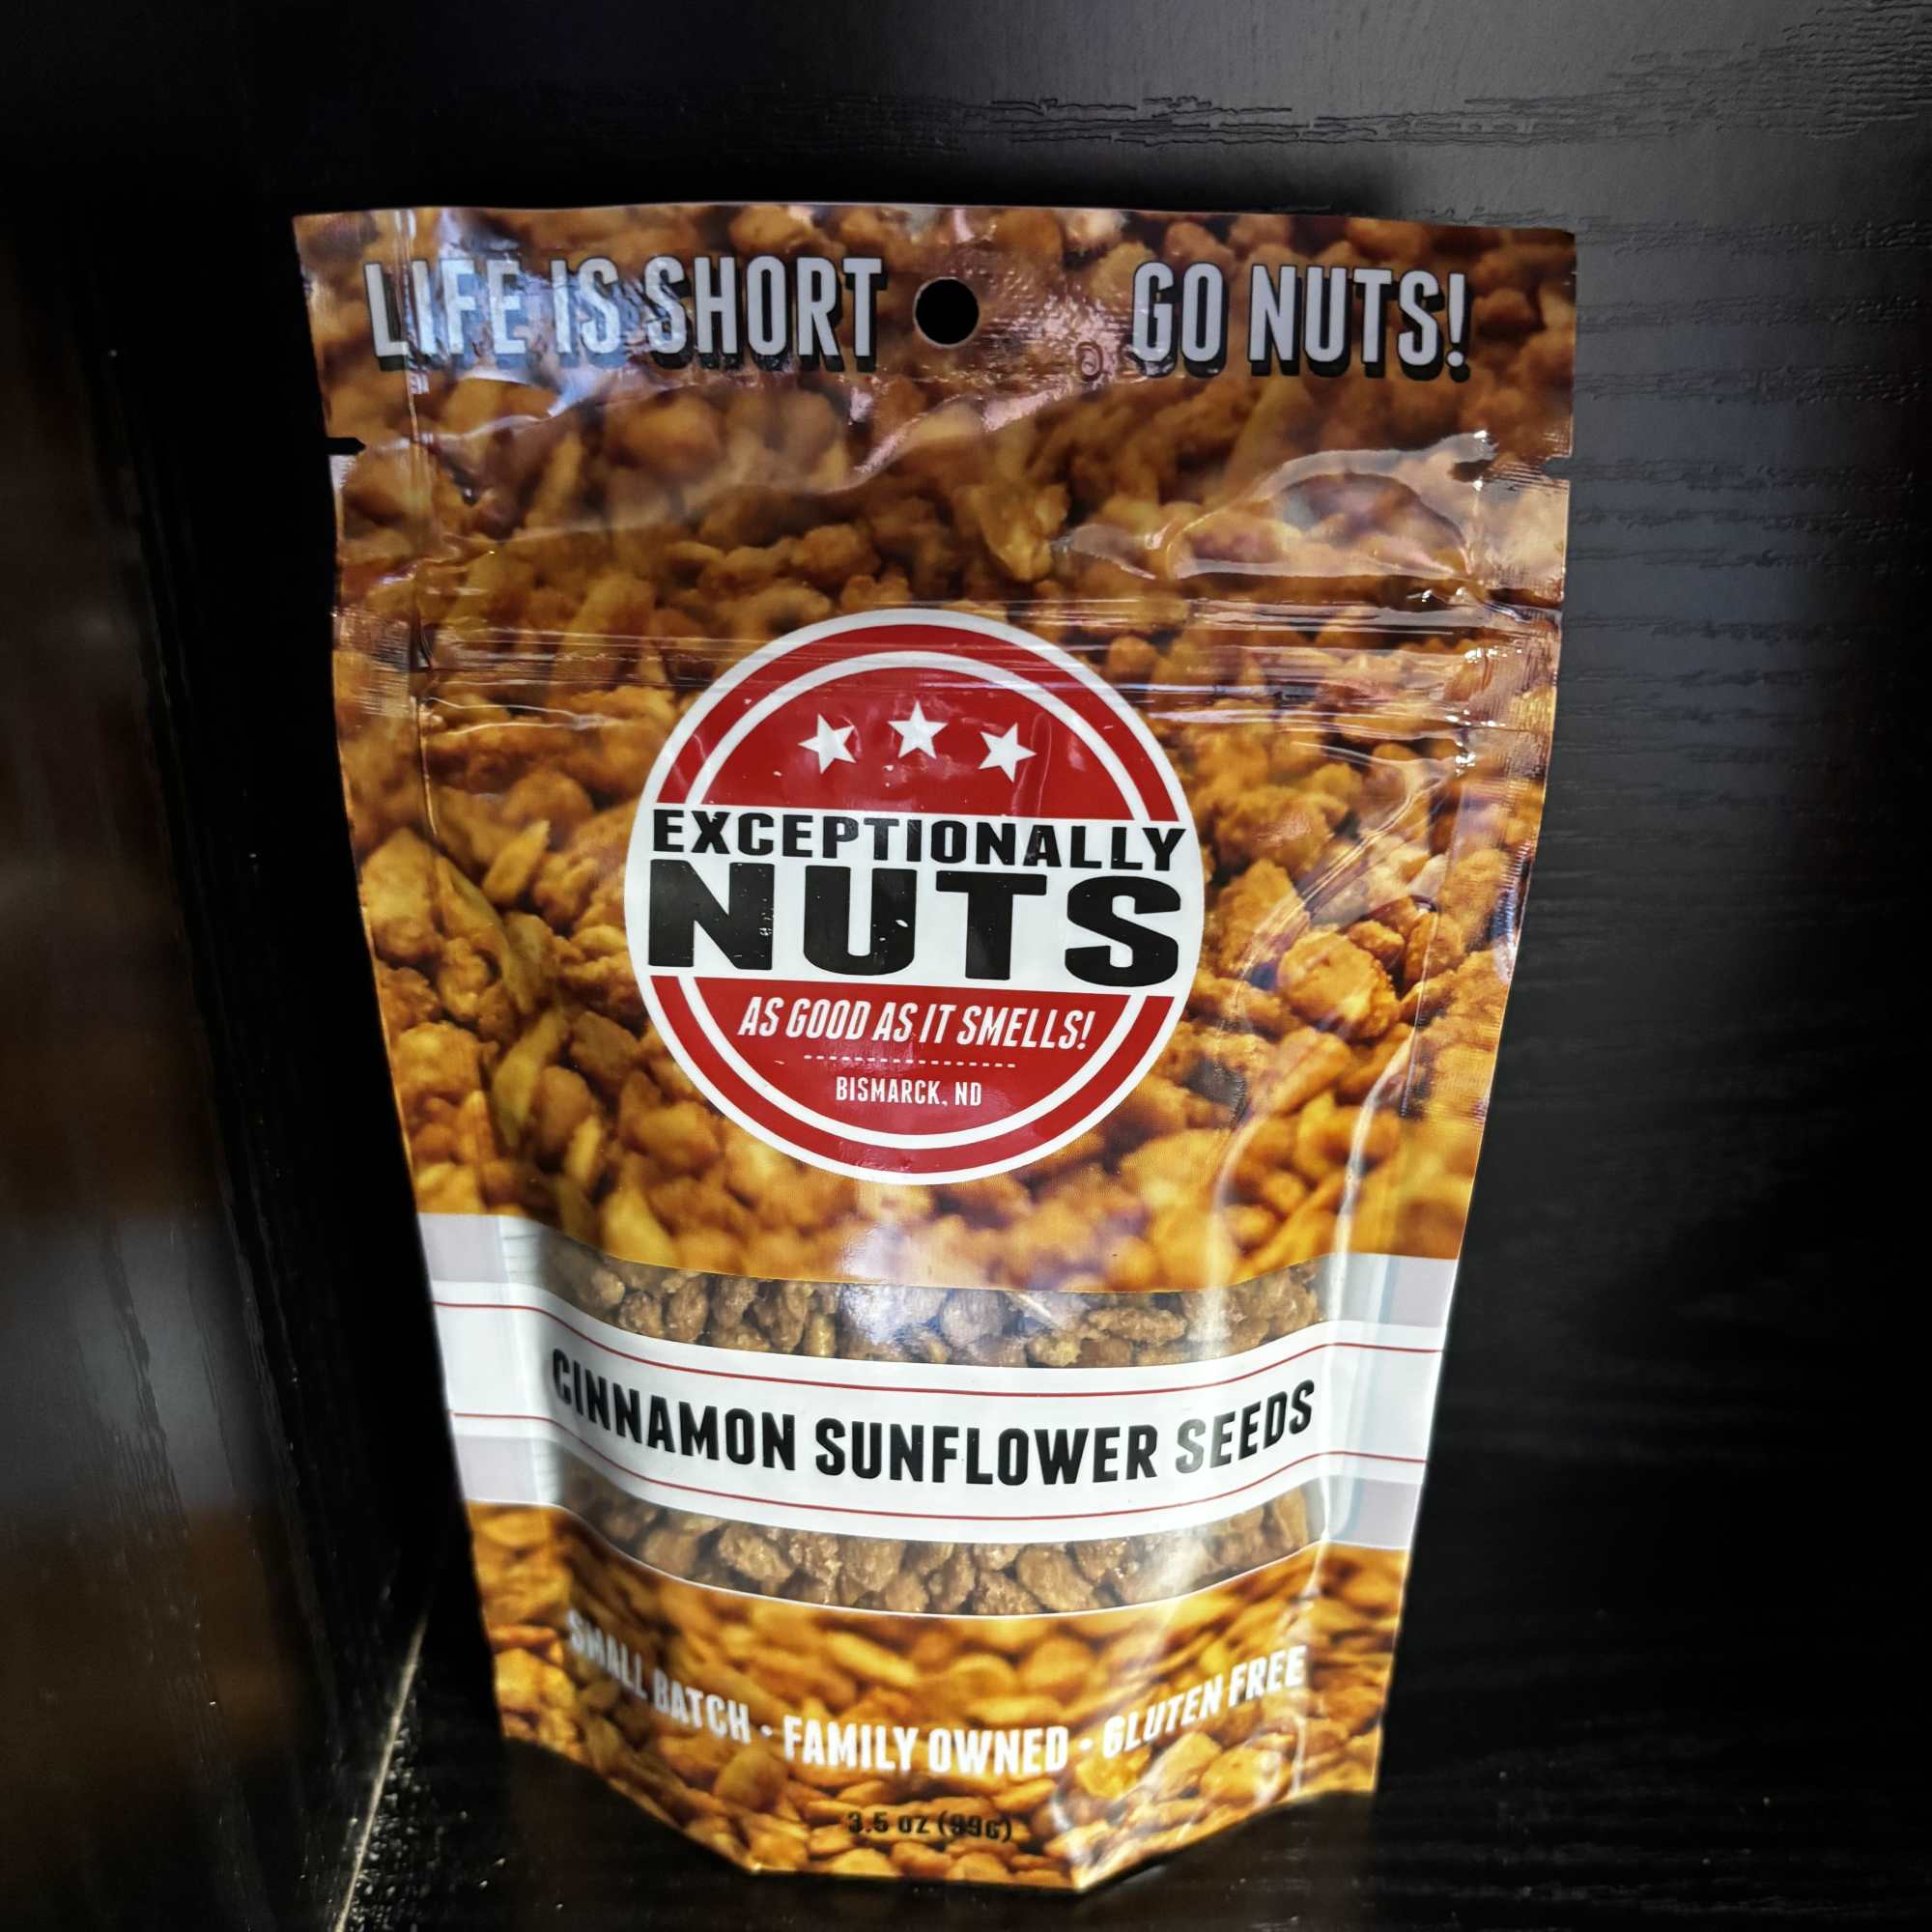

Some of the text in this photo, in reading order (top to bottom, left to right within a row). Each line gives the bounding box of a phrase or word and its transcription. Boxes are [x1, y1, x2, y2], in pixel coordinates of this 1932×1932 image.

[363, 255, 884, 361] LIFE IS SHORT
[1132, 262, 1468, 372] GO NUTS!
[652, 809, 1185, 871] EXCEPTIONALLY
[648, 859, 1181, 987] NUTS
[737, 996, 1096, 1050] AS GOOD AS IT SMELLS!
[836, 1076, 982, 1107] BISMARCK, ND
[551, 1348, 1316, 1486] CINNAMON SUNFLOWER SEEDS
[567, 1608, 1308, 1776] SMALL BATCH FAMILY OWNED GLUTEN FREE
[848, 1811, 889, 1834] 3.5
